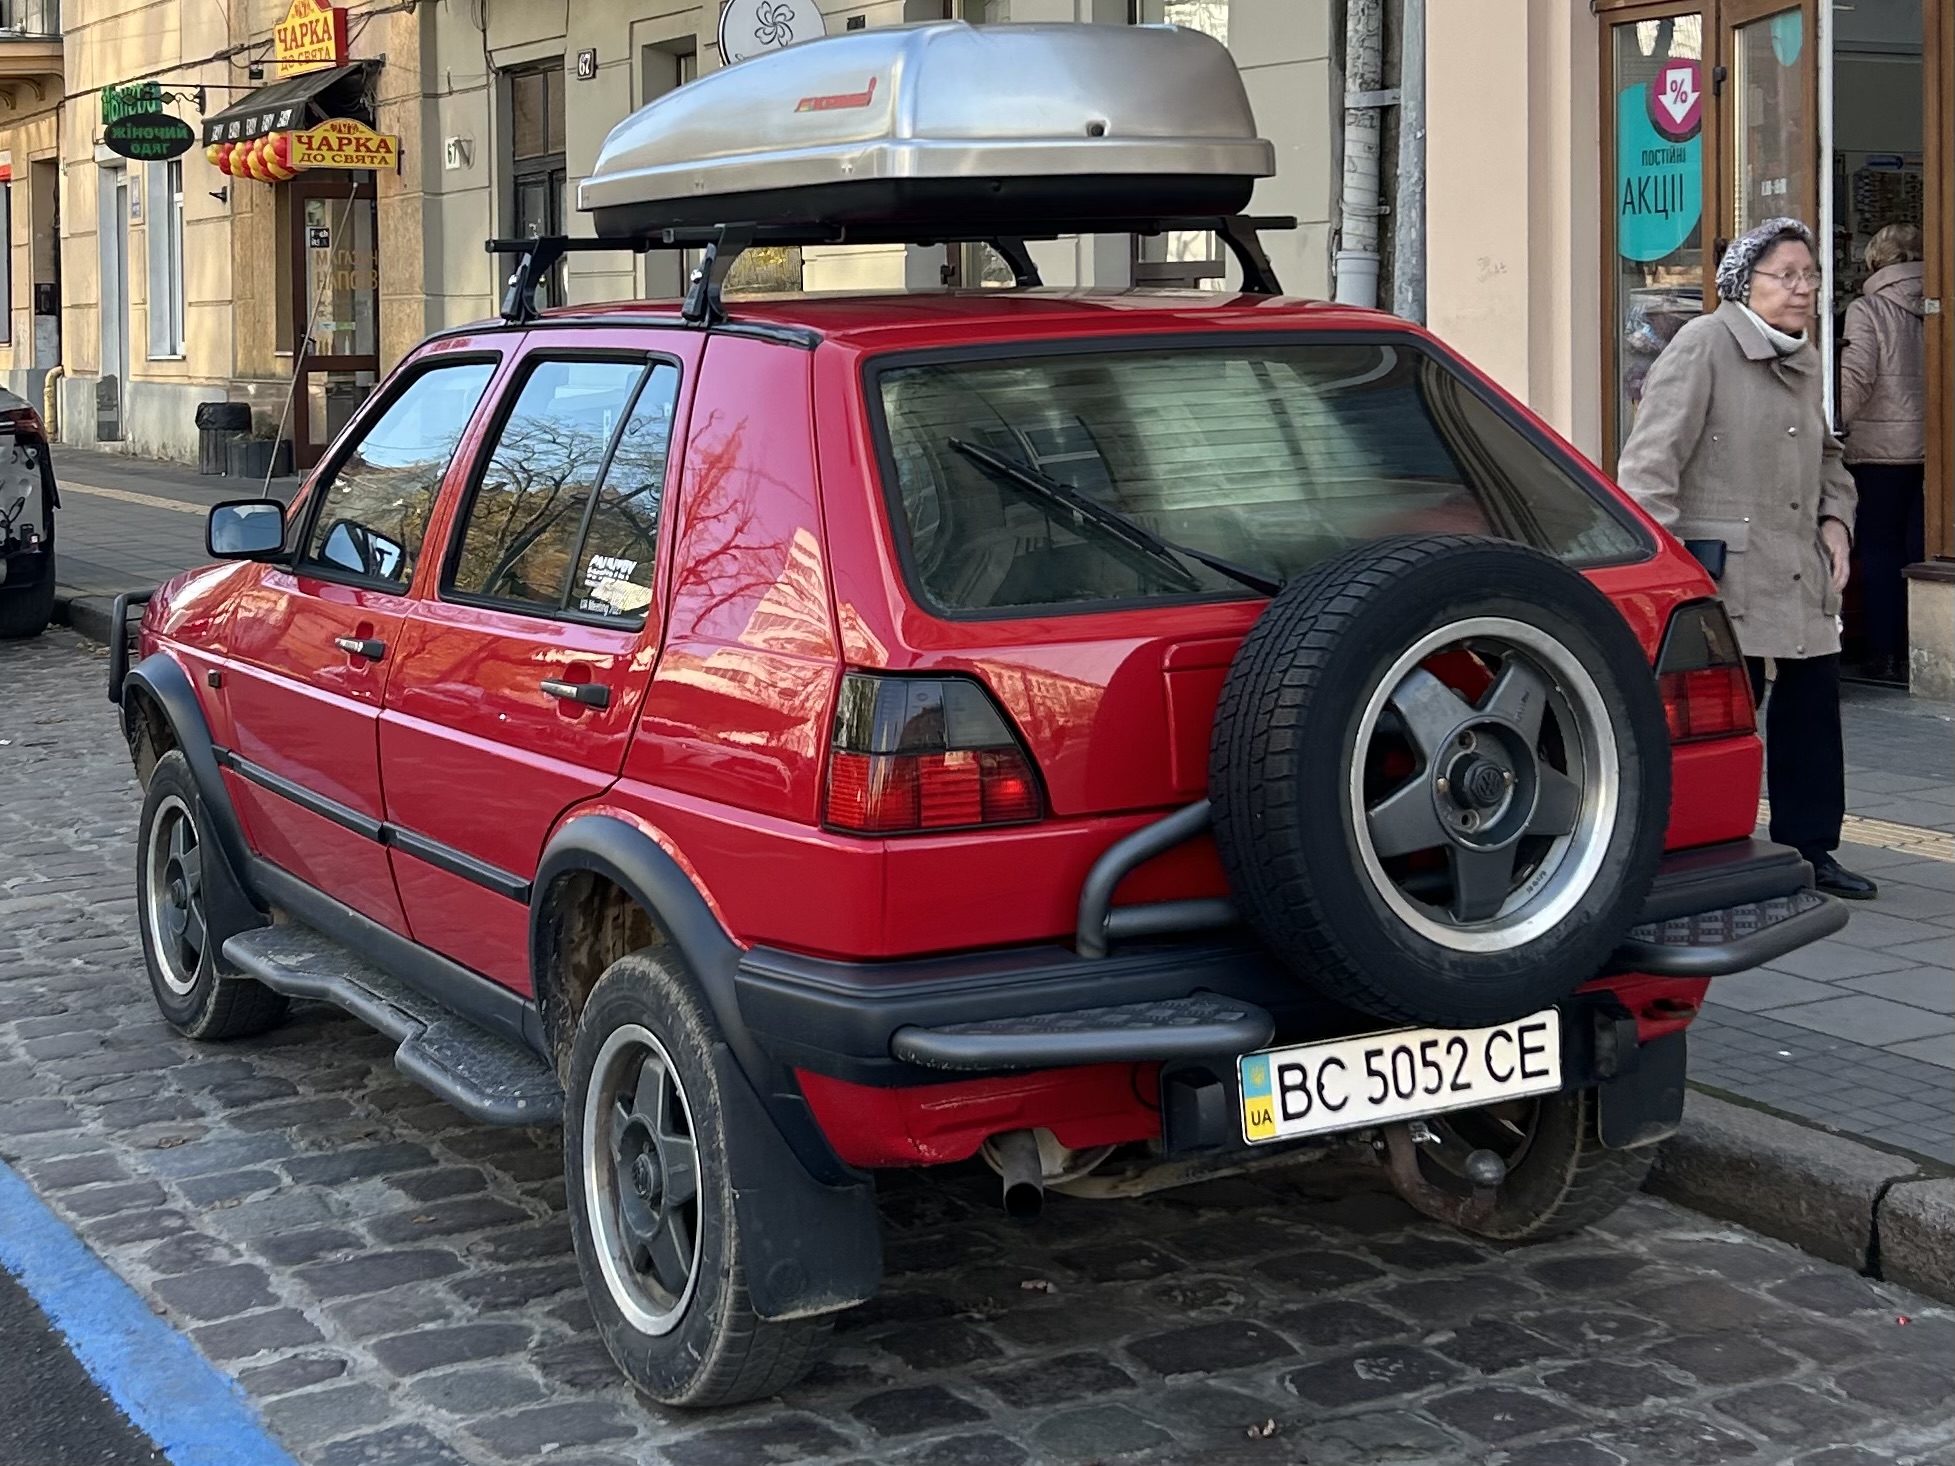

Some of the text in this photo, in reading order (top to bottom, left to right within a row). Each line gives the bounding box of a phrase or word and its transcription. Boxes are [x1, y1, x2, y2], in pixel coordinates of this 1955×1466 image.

[278, 16, 332, 52] ЧАРКА
[281, 46, 332, 71] ДО СВЯТА
[578, 53, 591, 76] 67
[295, 135, 393, 154] ЧАРКА
[299, 153, 390, 165] ДО СВЯТА
[1641, 145, 1686, 167] ПОСТІЙНІ
[1277, 1022, 1550, 1122] BC 5052 CE
[1250, 1107, 1273, 1126] UA
